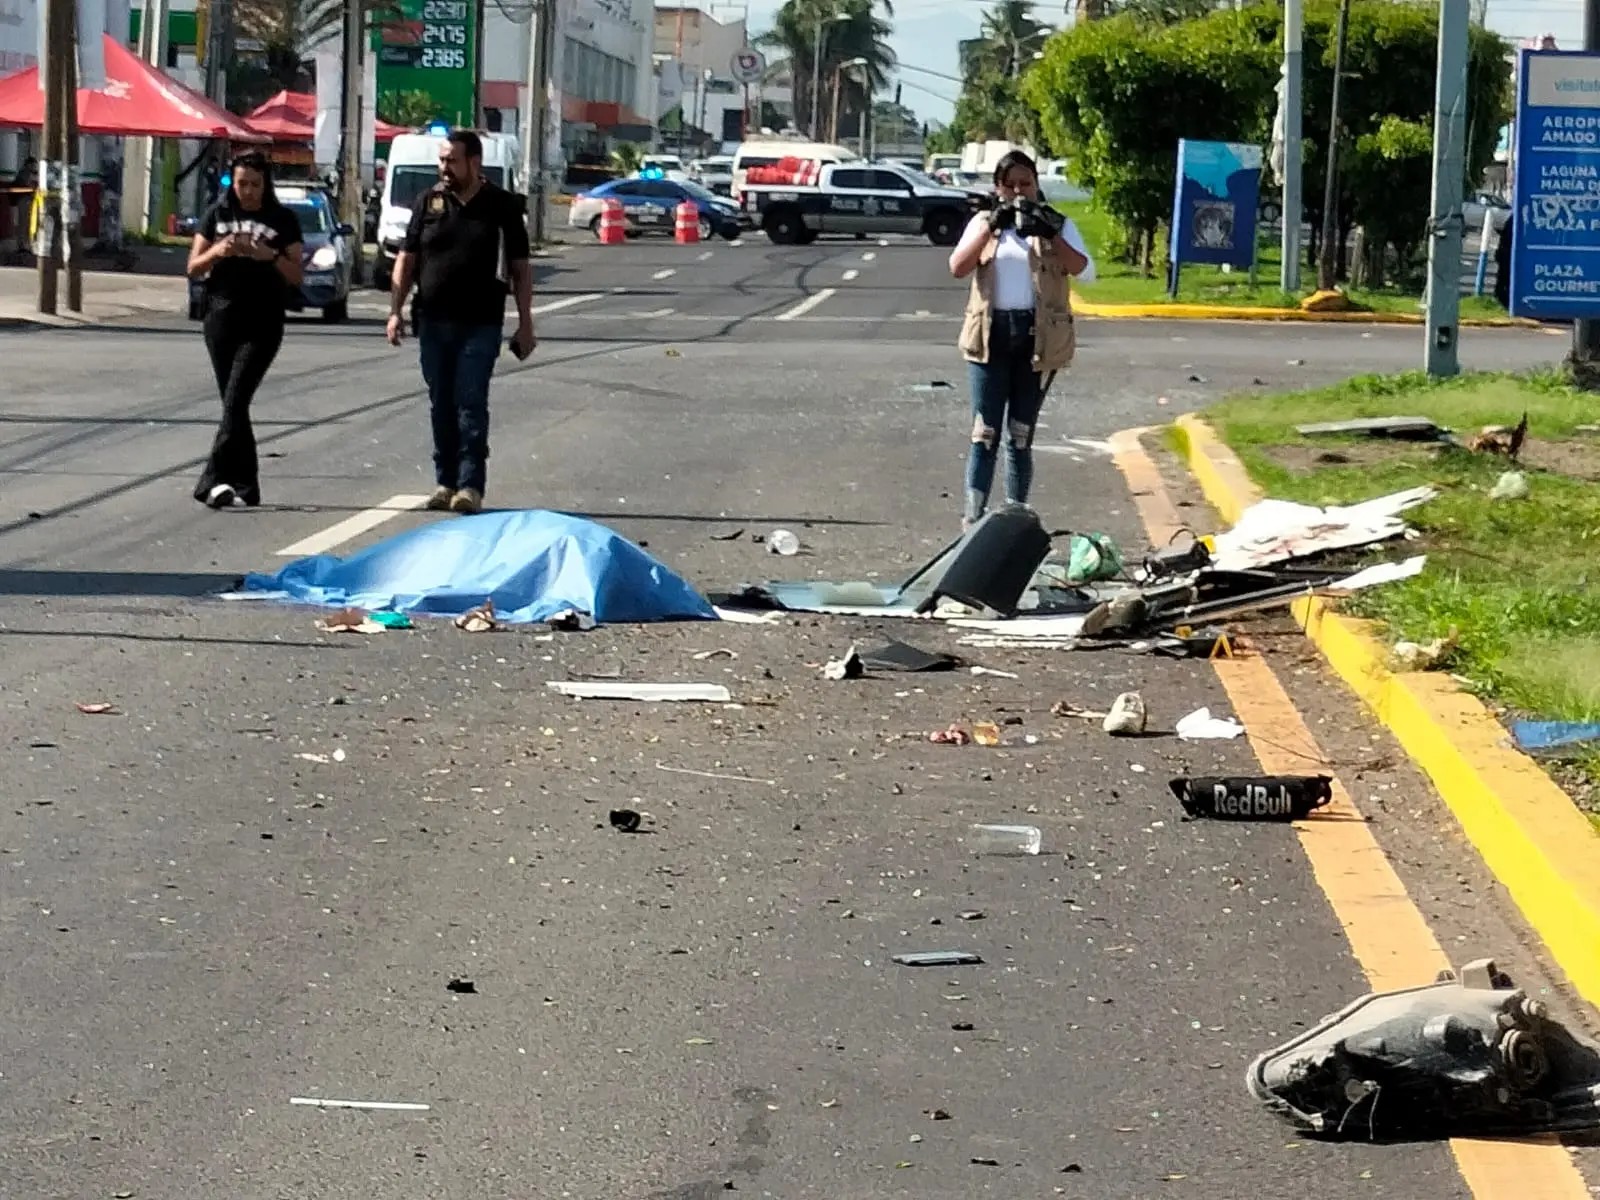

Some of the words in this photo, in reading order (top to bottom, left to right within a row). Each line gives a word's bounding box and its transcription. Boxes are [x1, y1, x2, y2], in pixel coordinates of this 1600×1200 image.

[423, 24, 466, 44] 2475
[421, 48, 465, 69] 2385
[1542, 130, 1596, 144] AMADO
[1541, 165, 1598, 178] LAGUNA
[1534, 264, 1585, 277] PLAZA
[1213, 783, 1251, 815] Red
[1253, 784, 1293, 816] Bull
